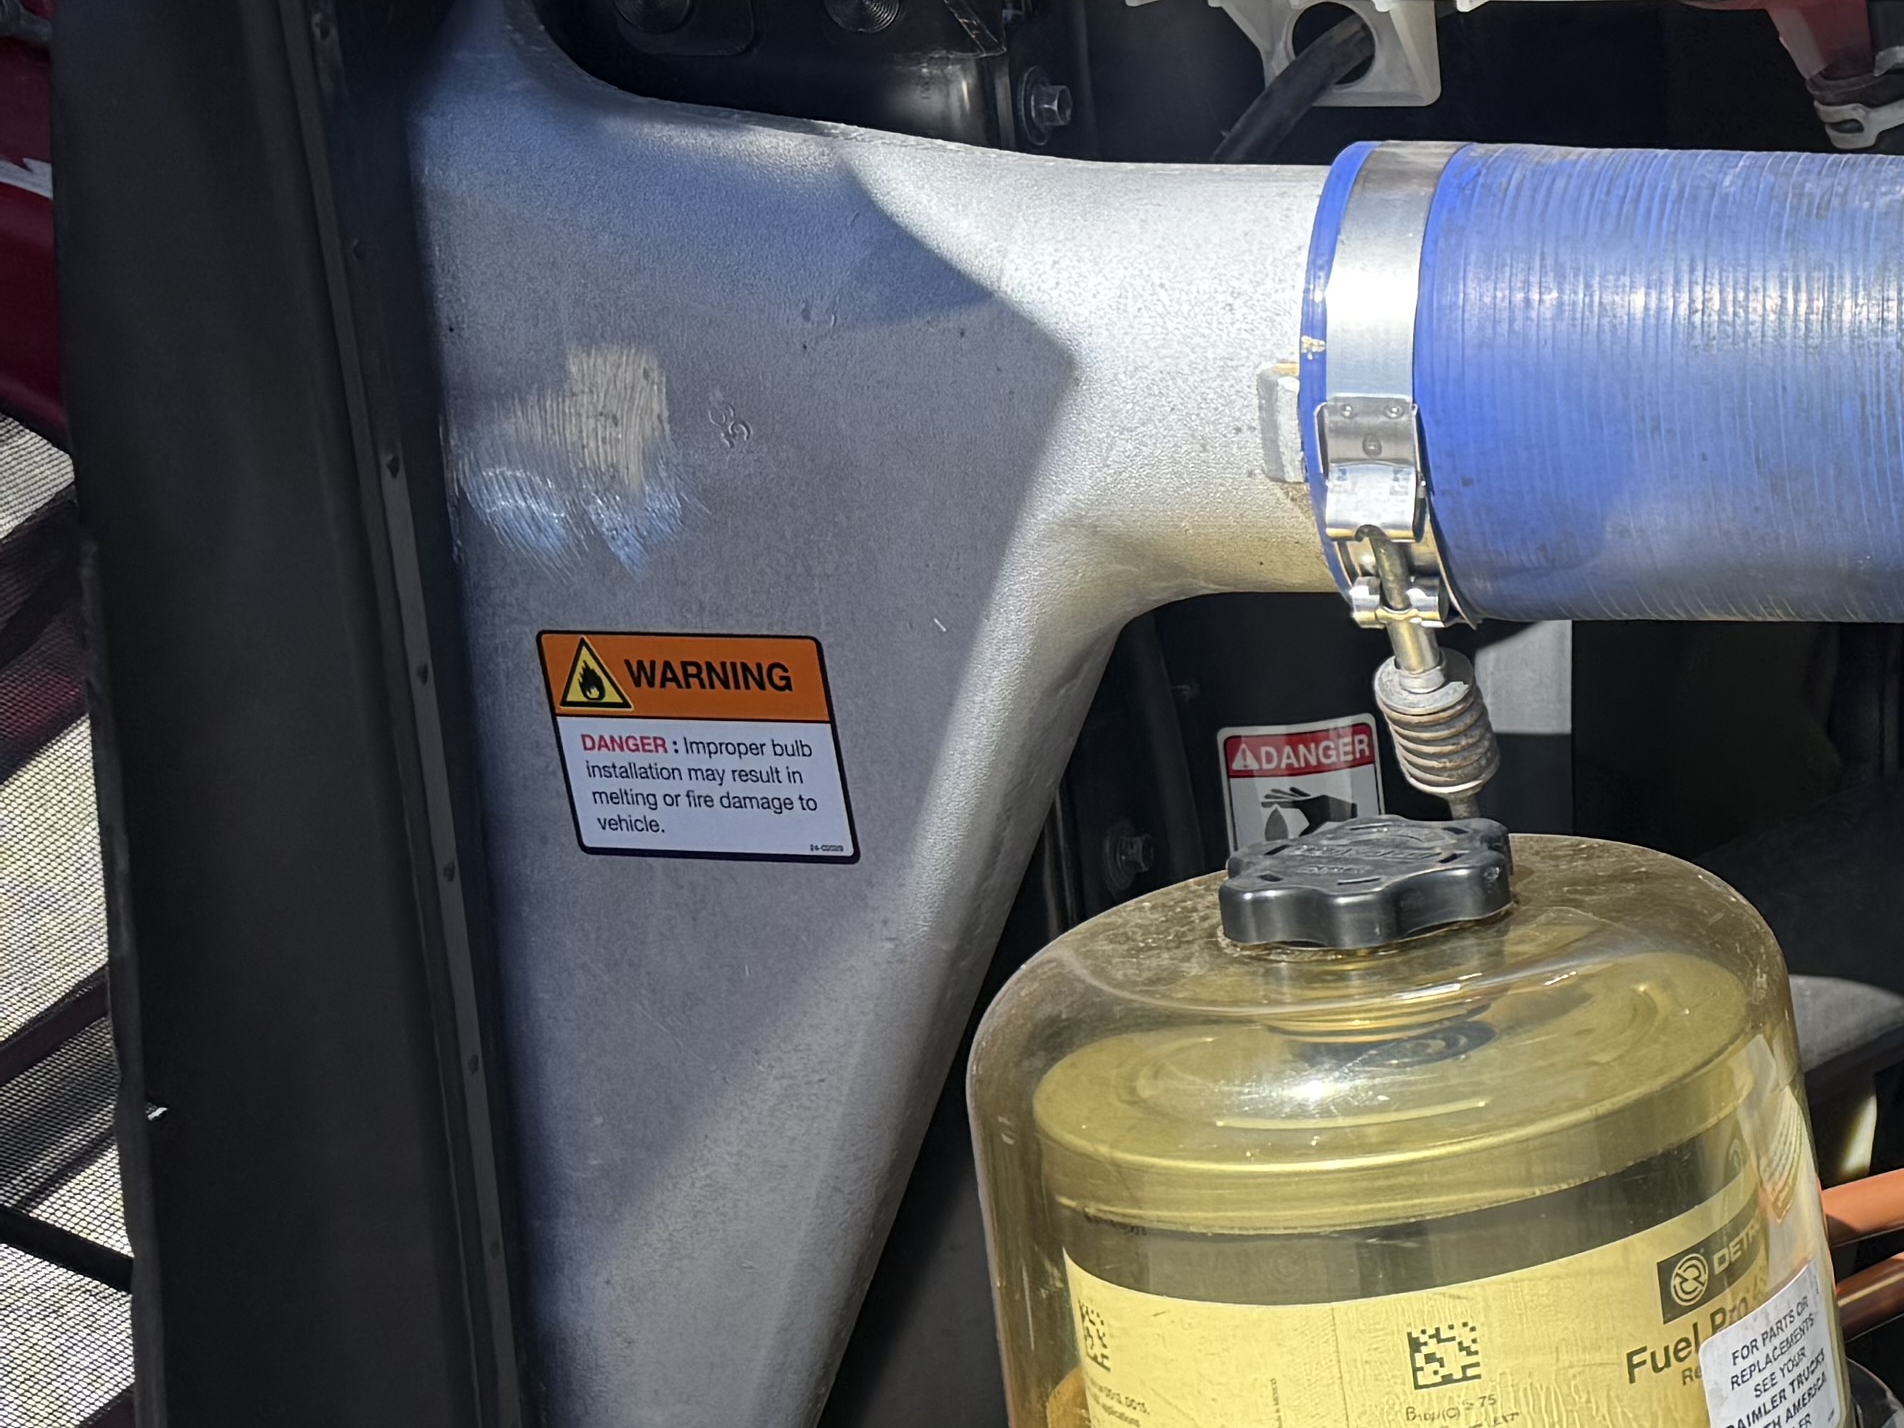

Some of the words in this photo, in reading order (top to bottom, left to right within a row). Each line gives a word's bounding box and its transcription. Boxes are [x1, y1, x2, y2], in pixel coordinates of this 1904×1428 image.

[623, 659, 793, 692] WARNING
[580, 734, 668, 754] DANGER
[684, 737, 765, 759] Improper
[772, 739, 812, 758] bulb
[1261, 734, 1370, 770] DANGER
[586, 760, 682, 780] installation
[688, 766, 725, 785] may
[731, 765, 780, 784] result
[786, 767, 803, 784] in
[592, 788, 658, 810] melting
[664, 792, 681, 807] or
[685, 791, 715, 808] fire
[720, 792, 793, 814] damage
[798, 794, 817, 811] to
[597, 815, 665, 834] vehicle.
[1731, 1339, 1760, 1366] FOR
[1762, 1310, 1794, 1346] PARTS
[1796, 1296, 1809, 1317] OR
[1626, 1324, 1700, 1385] Fuel
[1731, 1315, 1814, 1390] REPLACEMENTS
[1754, 1372, 1778, 1398] SEE
[1779, 1346, 1807, 1376] YOUR
[1789, 1348, 1826, 1393] TRUCKS
[1785, 1373, 1826, 1423] AMERICA
